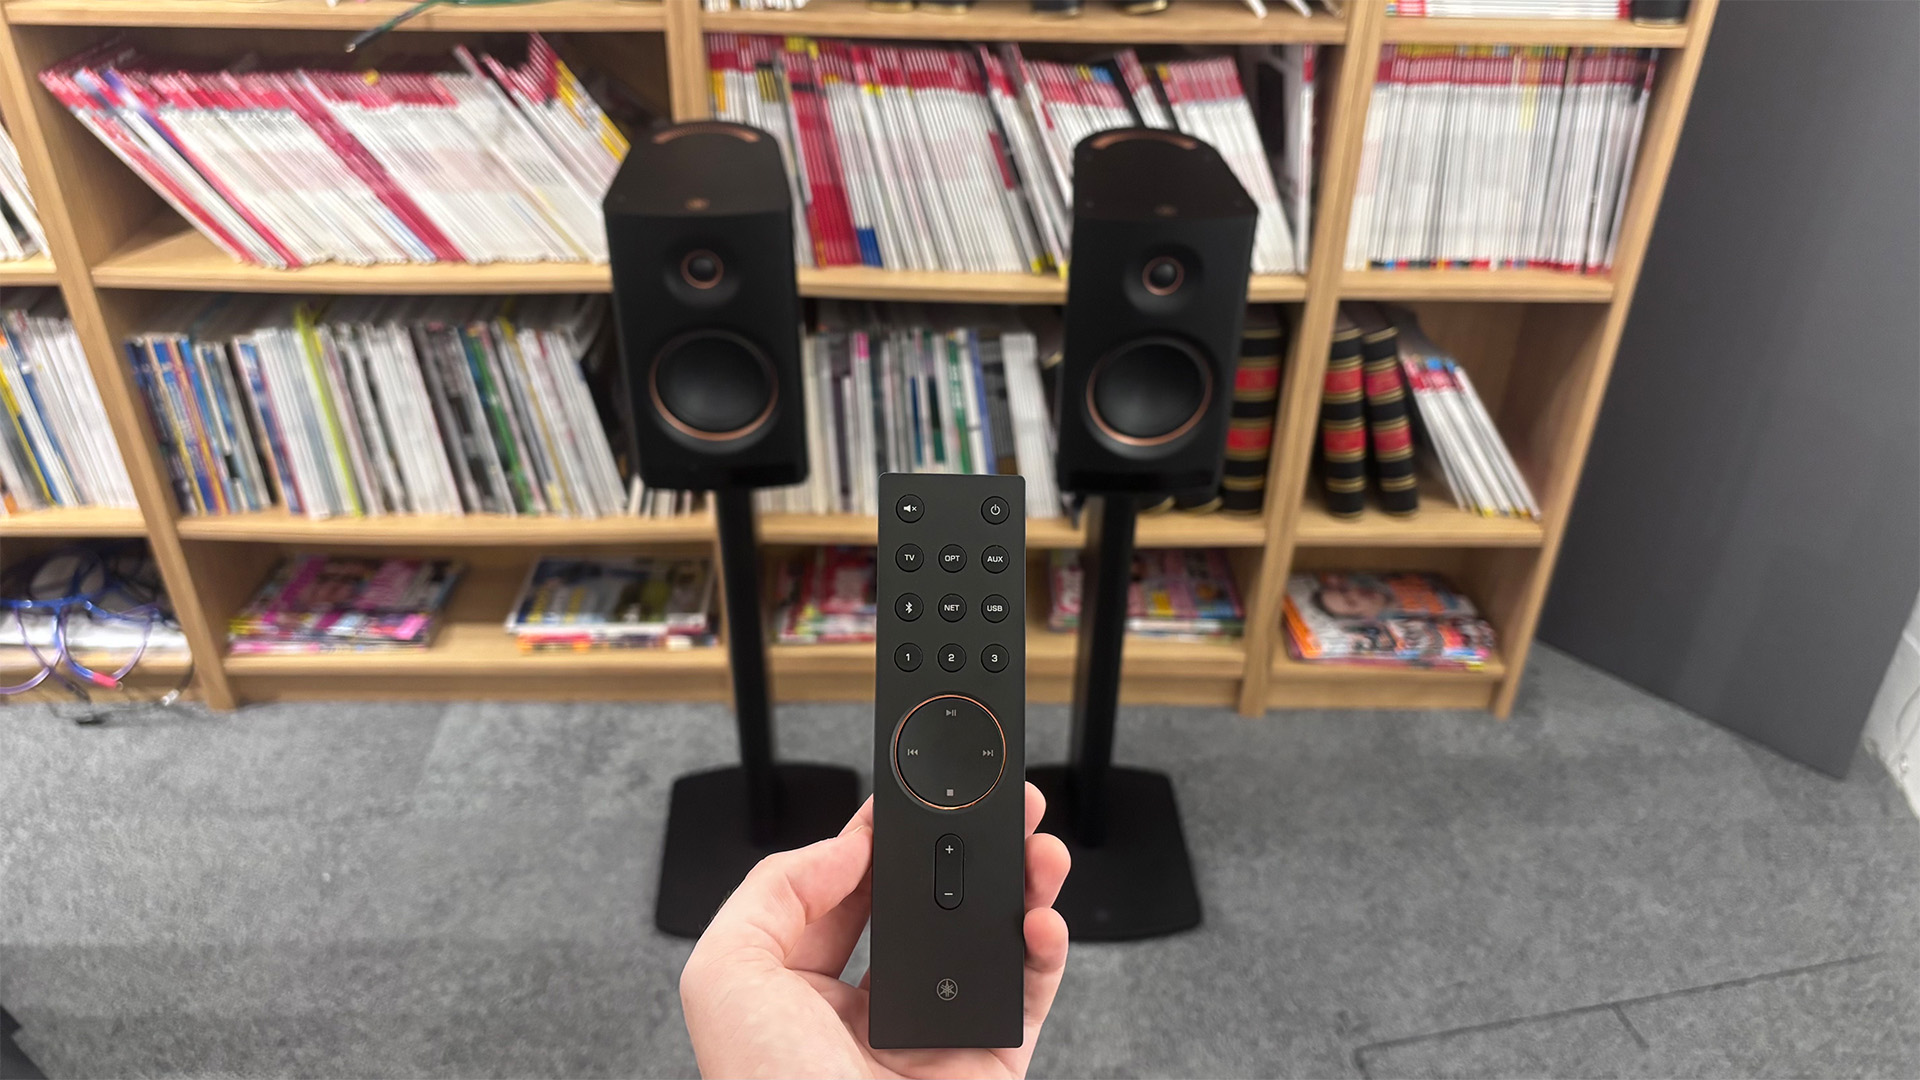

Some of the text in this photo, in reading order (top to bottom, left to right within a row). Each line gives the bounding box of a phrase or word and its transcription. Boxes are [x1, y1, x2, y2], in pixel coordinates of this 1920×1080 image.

[904, 553, 915, 561] TV
[944, 554, 960, 562] OPT
[986, 555, 1004, 563] AUX
[943, 604, 960, 612] NET
[986, 604, 1003, 612] USB
[948, 653, 955, 662] 2
[991, 654, 998, 663] 3
